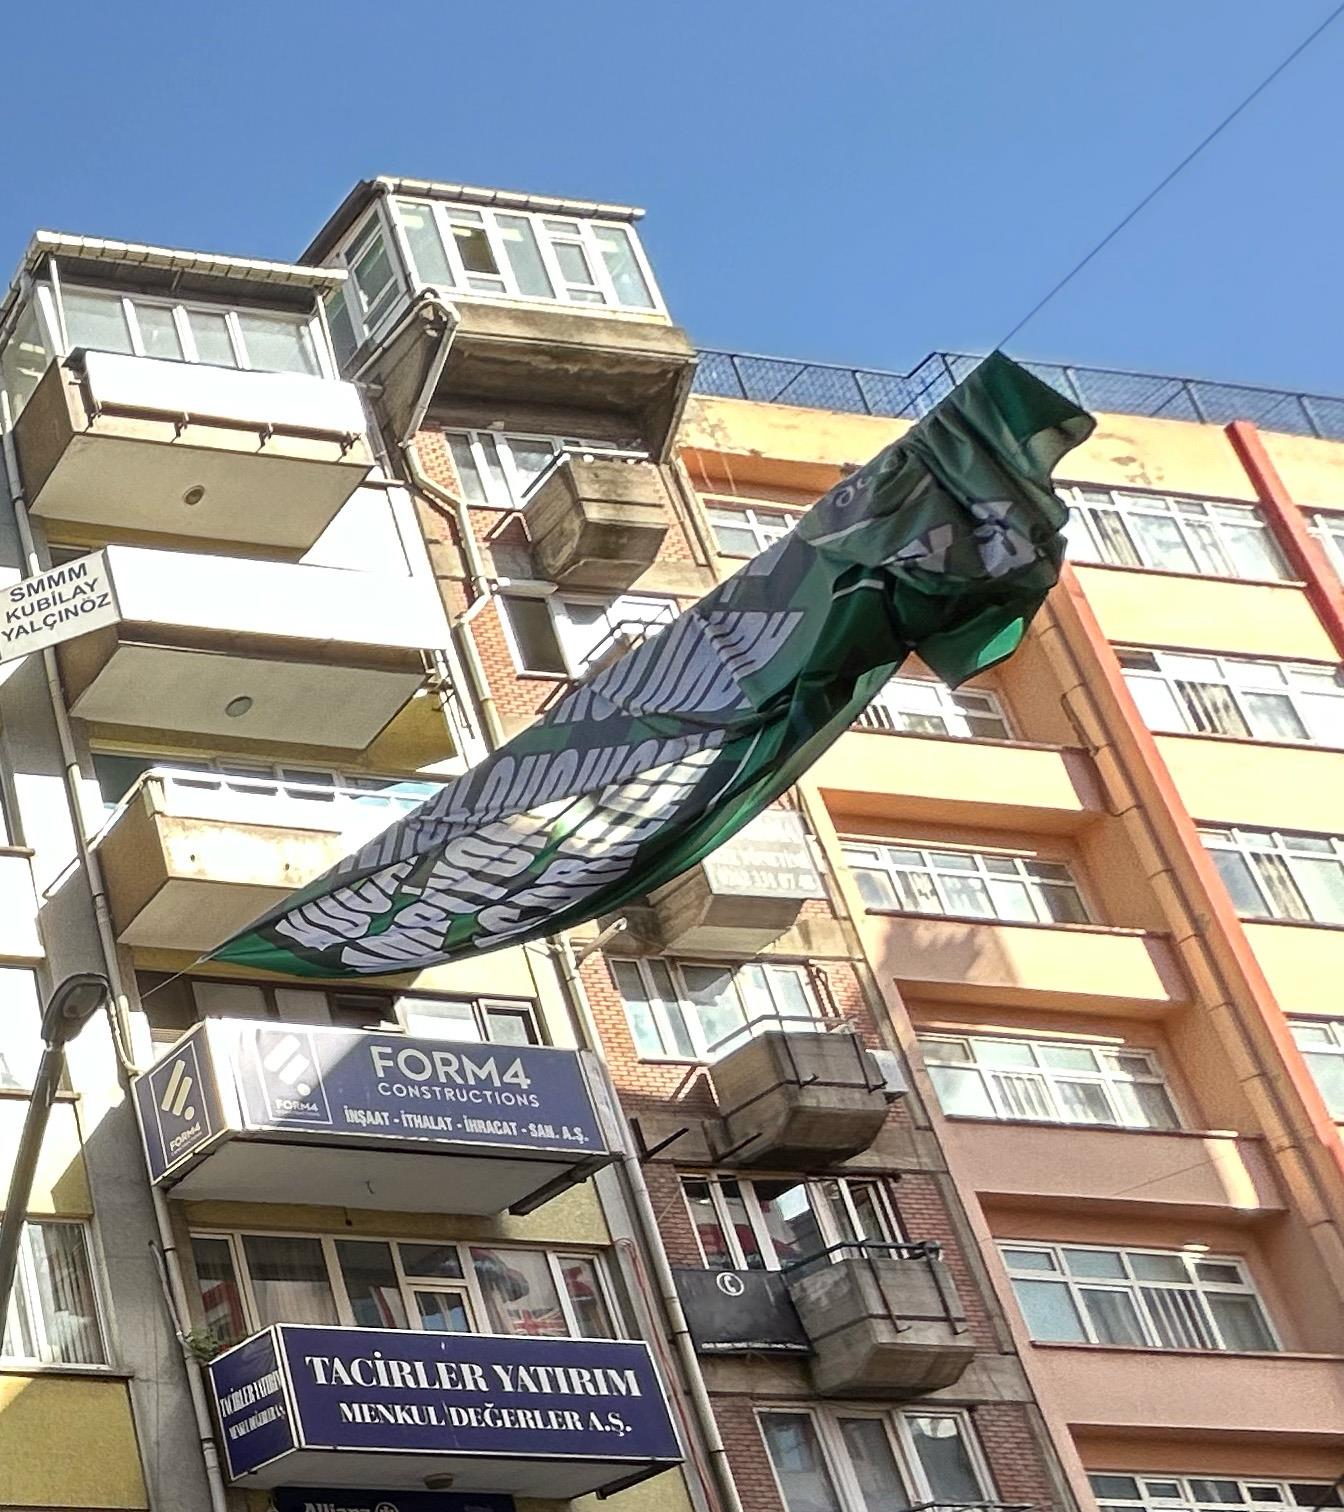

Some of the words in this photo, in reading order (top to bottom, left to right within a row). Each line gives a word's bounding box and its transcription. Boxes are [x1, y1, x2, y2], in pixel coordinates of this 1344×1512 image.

[6, 577, 100, 624] KUBİLAY
[10, 562, 89, 603] SMMM
[1, 592, 112, 643] YALÇINÖZ
[369, 1045, 532, 1090] FORM4
[377, 1082, 541, 1109] CONSTRUCTIONS
[343, 1105, 390, 1128] İNŞAAT
[400, 1110, 453, 1132] İTHALAT
[463, 1115, 518, 1137] İHRACAT
[304, 1350, 490, 1393] TACİRLER
[491, 1364, 642, 1397] YATIRIM
[339, 1402, 445, 1427] MENKUL
[448, 1402, 584, 1432] DEĞERLER
[588, 1412, 633, 1437] A.Ş.
